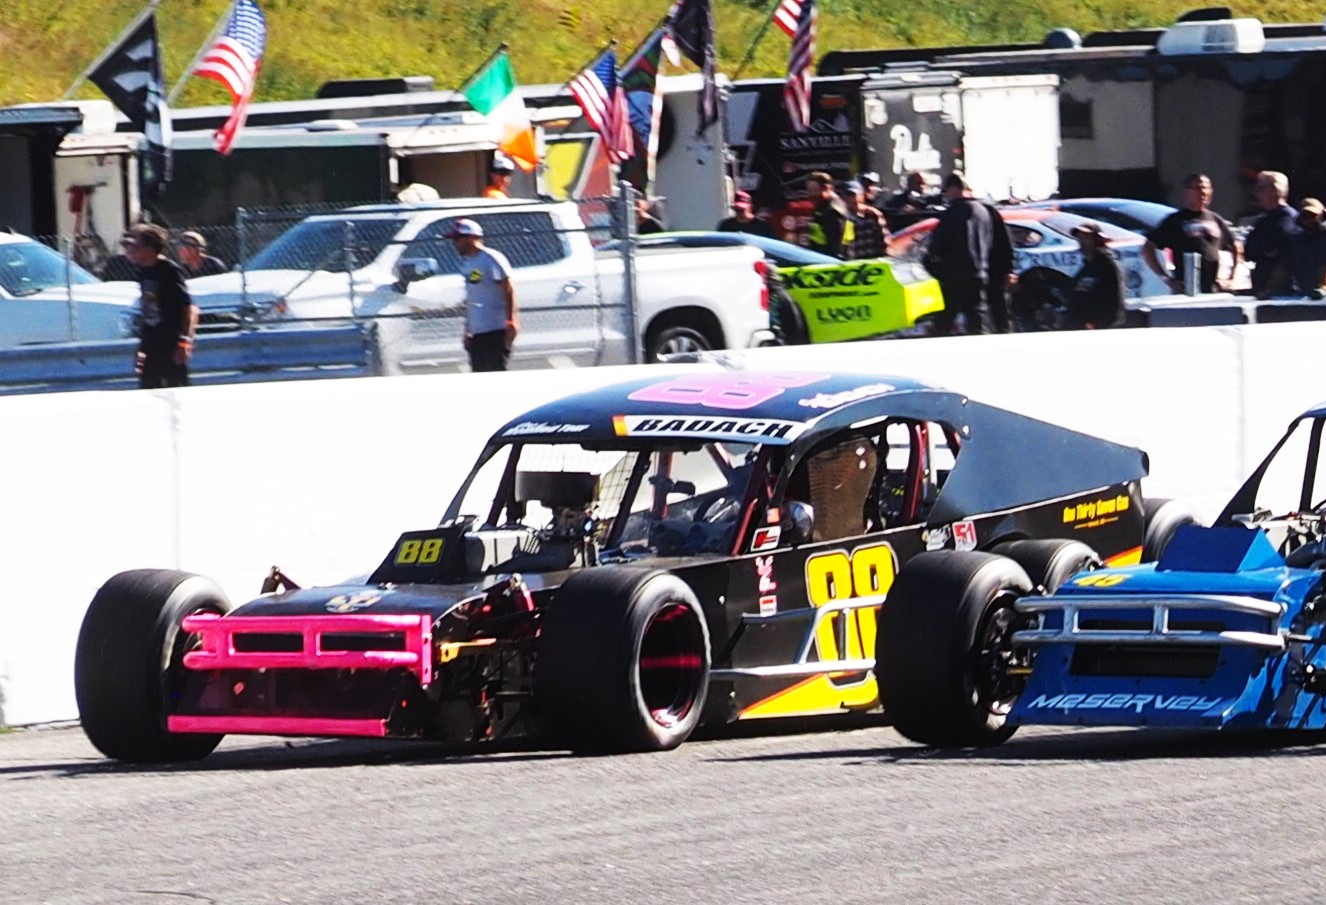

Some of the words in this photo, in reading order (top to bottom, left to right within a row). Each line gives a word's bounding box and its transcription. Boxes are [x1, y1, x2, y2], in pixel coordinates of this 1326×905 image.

[632, 418, 794, 439] BADACH
[397, 538, 443, 565] 88
[1027, 694, 1222, 713] MESERVEY
